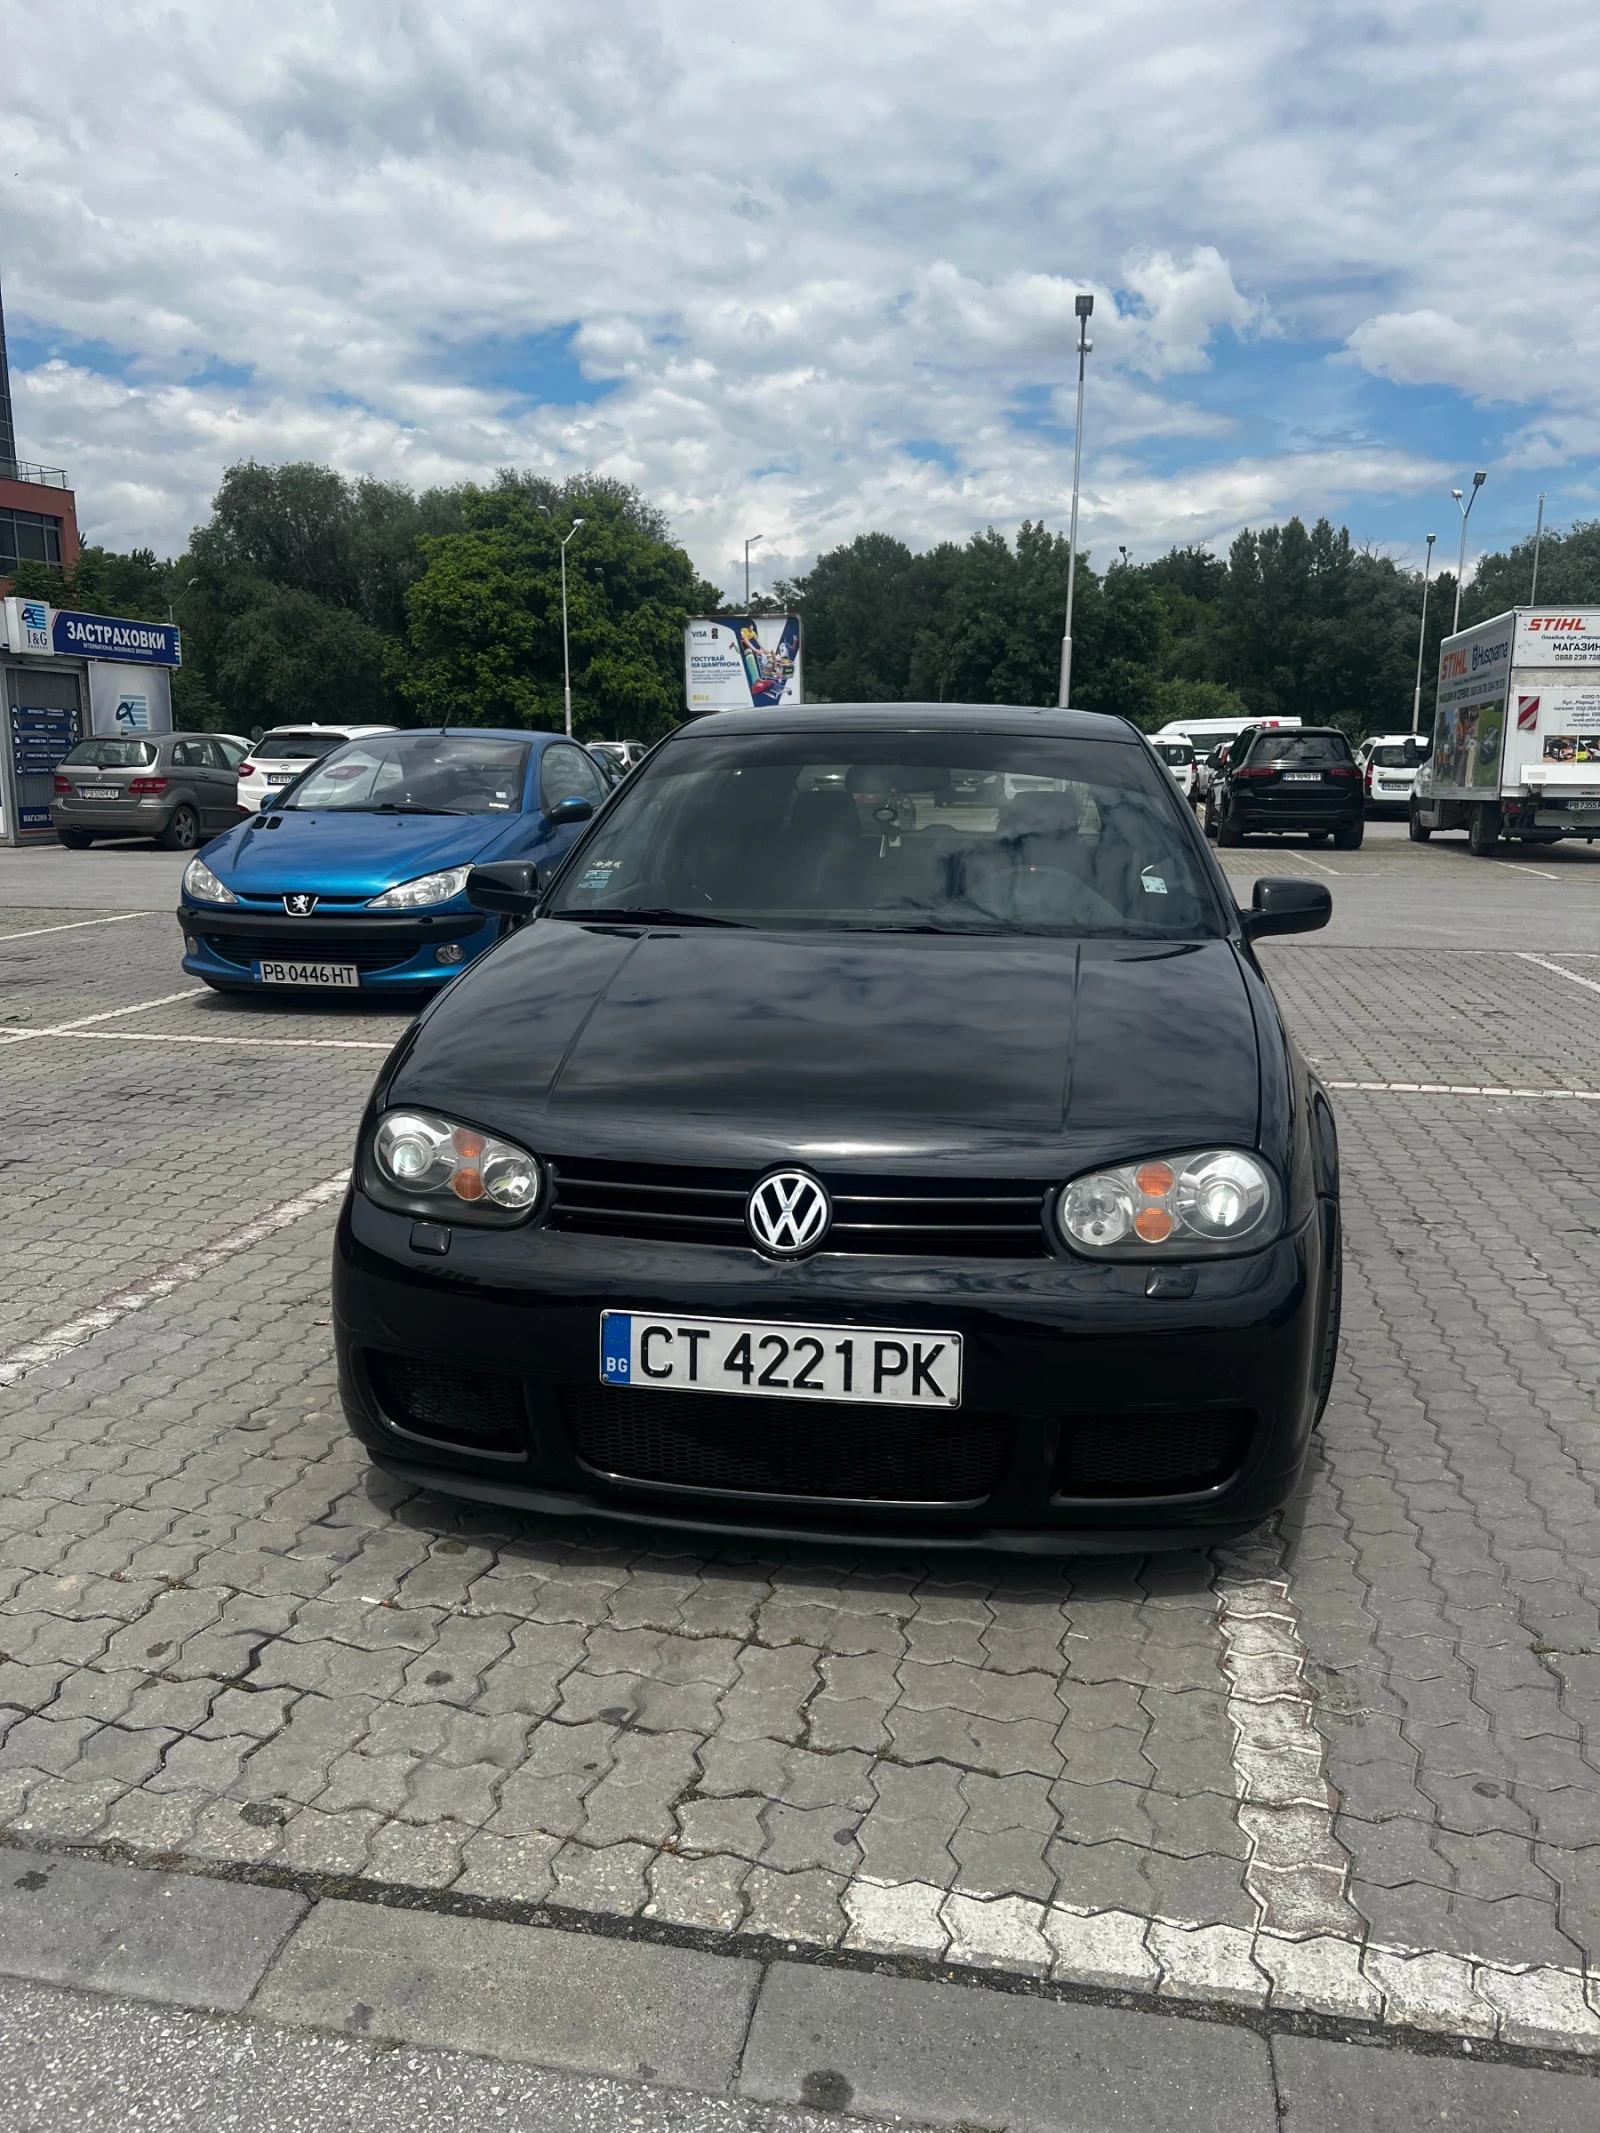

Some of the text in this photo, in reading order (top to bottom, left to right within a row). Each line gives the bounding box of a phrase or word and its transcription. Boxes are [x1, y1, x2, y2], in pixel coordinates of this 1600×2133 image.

[1528, 618, 1586, 631] STIHL
[66, 621, 166, 650] ЗАСТРАХОВКИ
[83, 642, 114, 652] INTERNATIONAL
[1441, 648, 1468, 681] STIHL
[1569, 801, 1579, 809] PB
[1580, 801, 1597, 809] 7355
[23, 814, 47, 822] МАГАЗИН
[263, 963, 354, 984] PB 0446 HT
[606, 1356, 628, 1373] BG
[640, 1325, 946, 1398] CT 4221 PK
